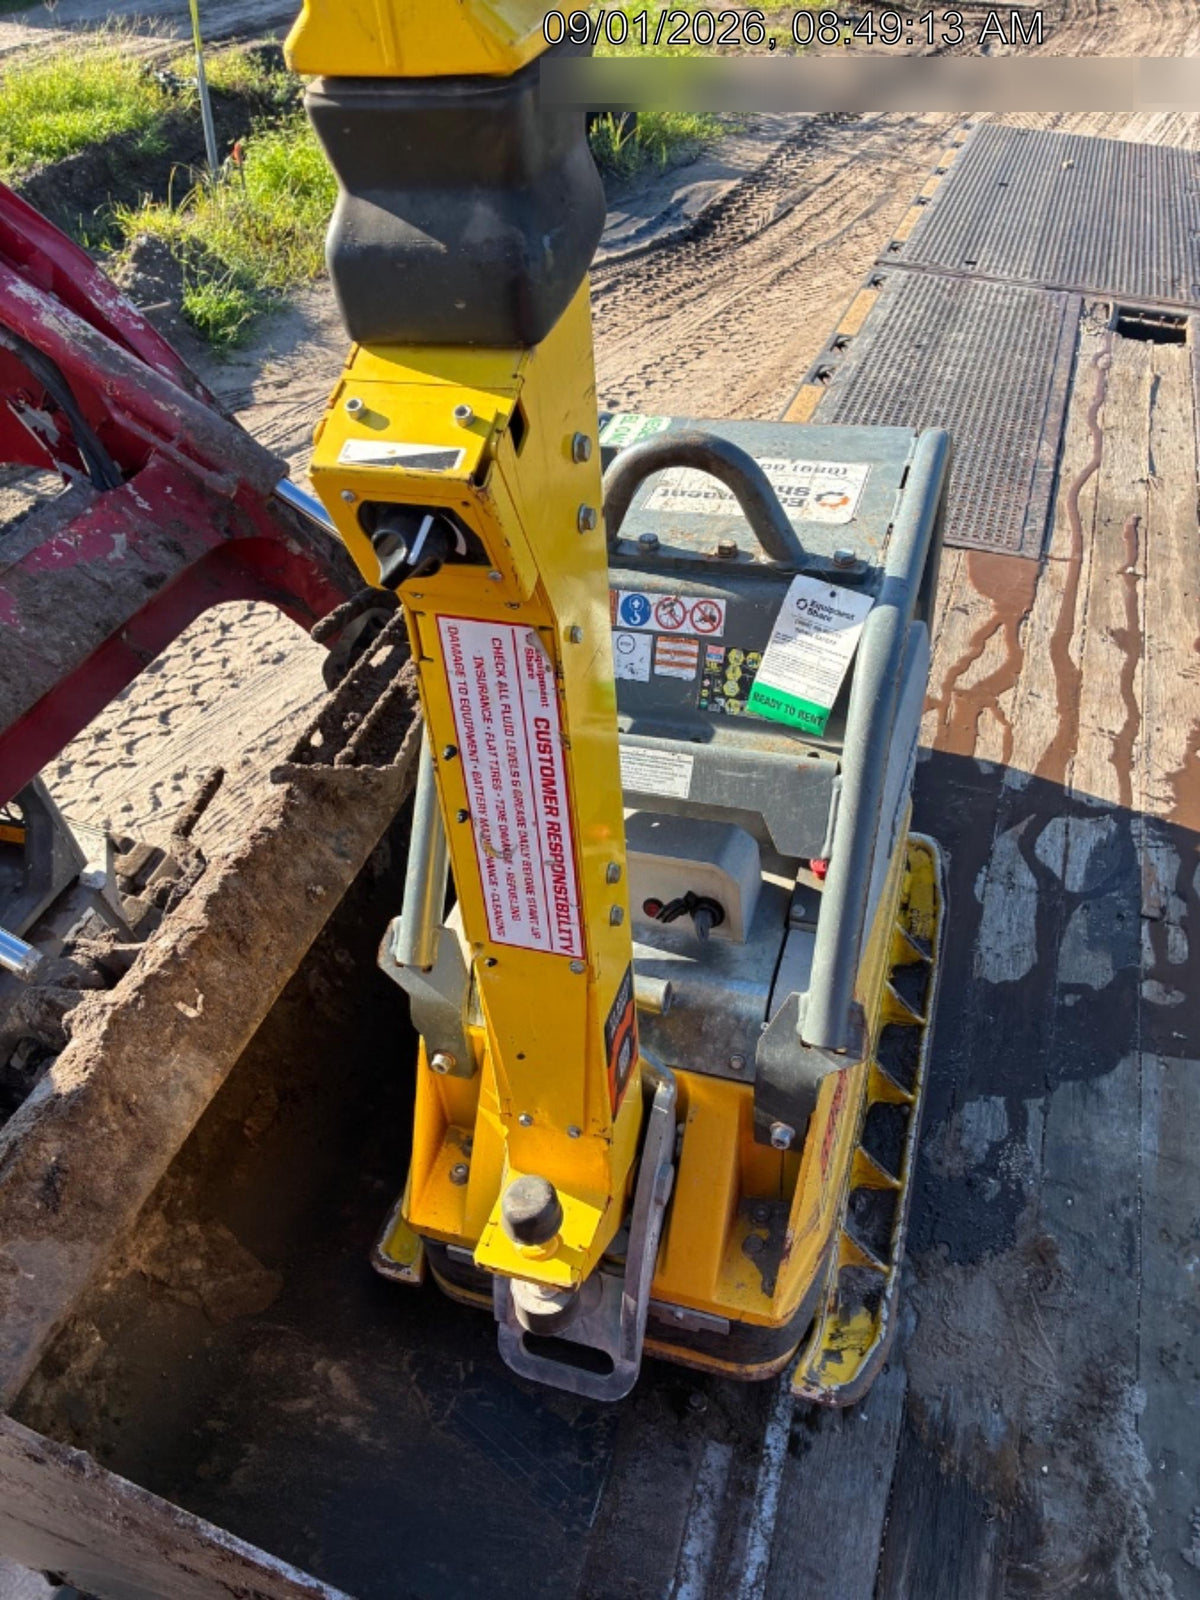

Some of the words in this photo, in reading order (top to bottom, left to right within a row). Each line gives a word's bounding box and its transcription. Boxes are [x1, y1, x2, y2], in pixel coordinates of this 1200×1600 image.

[447, 626, 467, 678] DAMAGE
[491, 637, 507, 679] CHECK
[523, 646, 535, 680] Share
[457, 680, 468, 696] TO
[472, 655, 493, 724] INSURANCE
[498, 679, 511, 701] ALL
[501, 703, 515, 737] FLUID
[753, 692, 783, 712] READY
[784, 703, 796, 716] TO
[797, 708, 825, 727] RENT
[459, 698, 480, 763] EQUIPMENT
[485, 732, 498, 757] FLAT
[488, 760, 502, 792] TIRES
[506, 740, 520, 778] LEVELS
[533, 716, 560, 817] CUSTOMER
[471, 771, 487, 817] BATTERY
[495, 799, 507, 822] TIRE
[511, 789, 527, 829] GREASE
[498, 824, 513, 866] DAMAGE
[518, 830, 531, 860] DAILY
[505, 871, 521, 922] REFUELING
[522, 861, 536, 897] BEFORE
[544, 818, 575, 954] RESPONSIBILITY
[490, 893, 506, 937] CLEANING
[527, 897, 540, 927] START
